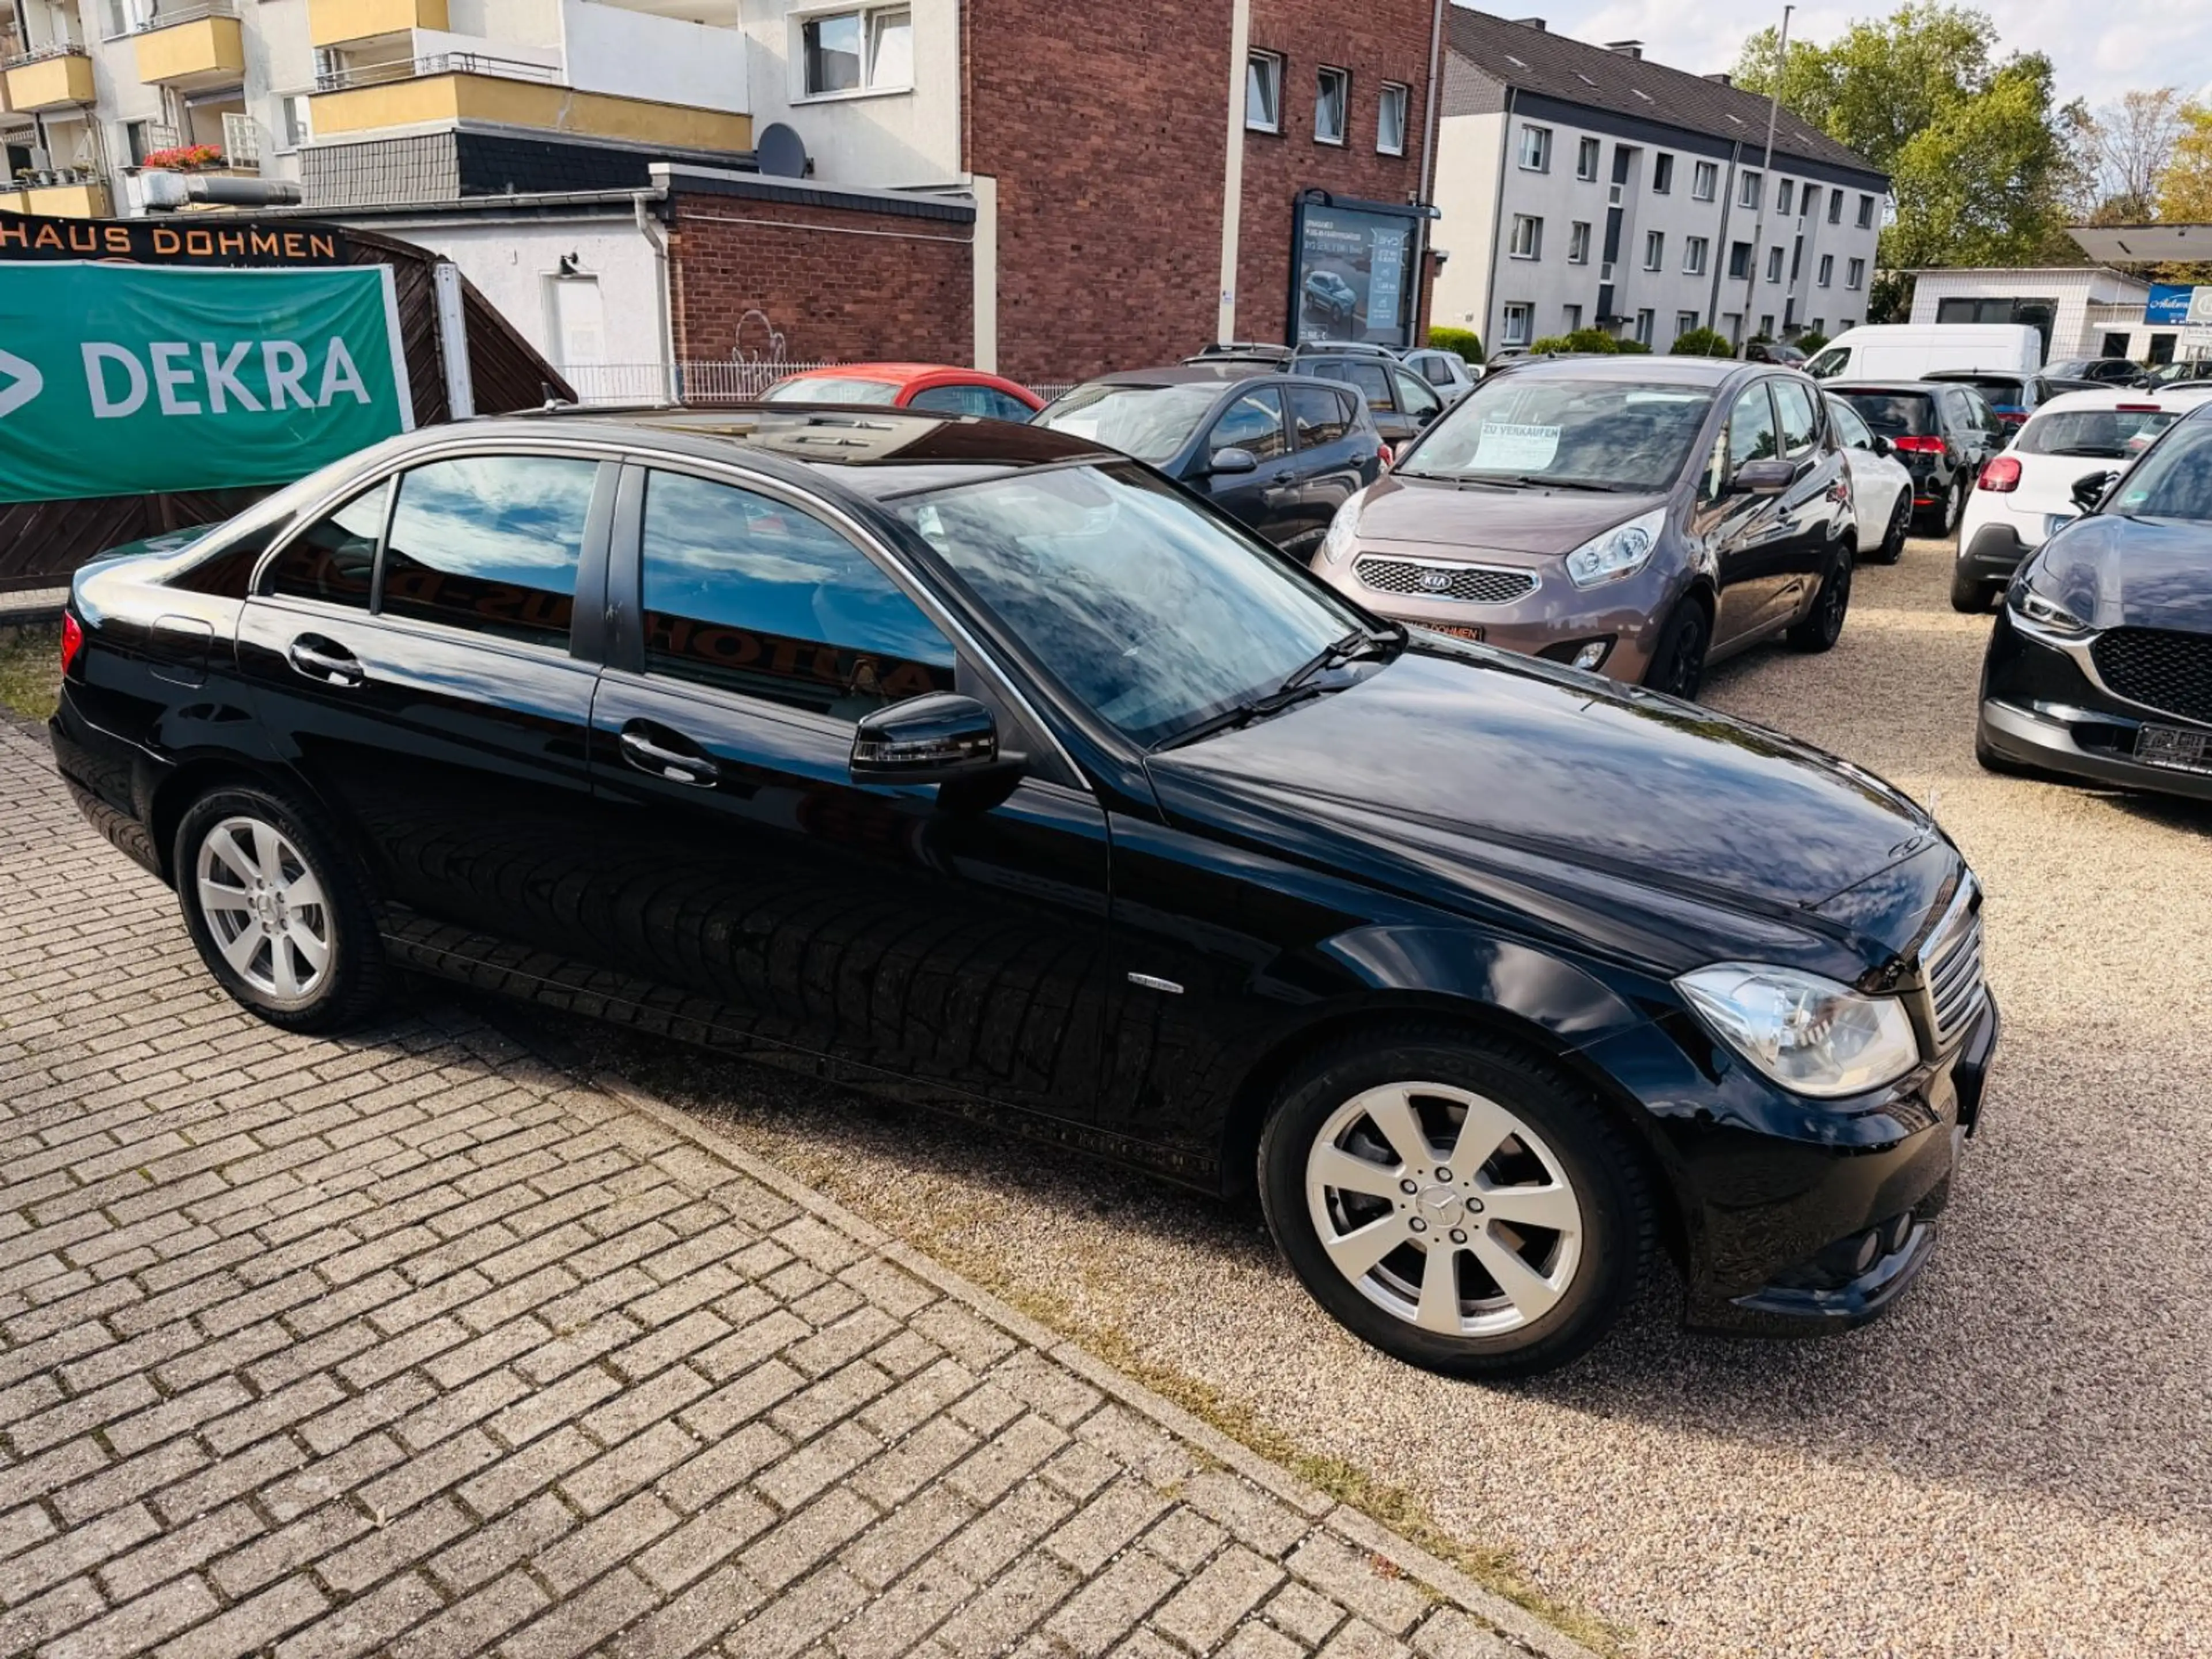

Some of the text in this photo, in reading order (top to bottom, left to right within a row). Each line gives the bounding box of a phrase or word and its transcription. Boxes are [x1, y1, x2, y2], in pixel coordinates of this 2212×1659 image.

[0, 221, 335, 258] HAUS DOHMEN
[81, 336, 372, 418] DEKRA
[1484, 425, 1558, 438] ZU VERKAUFEN
[1425, 576, 1445, 586] KIA
